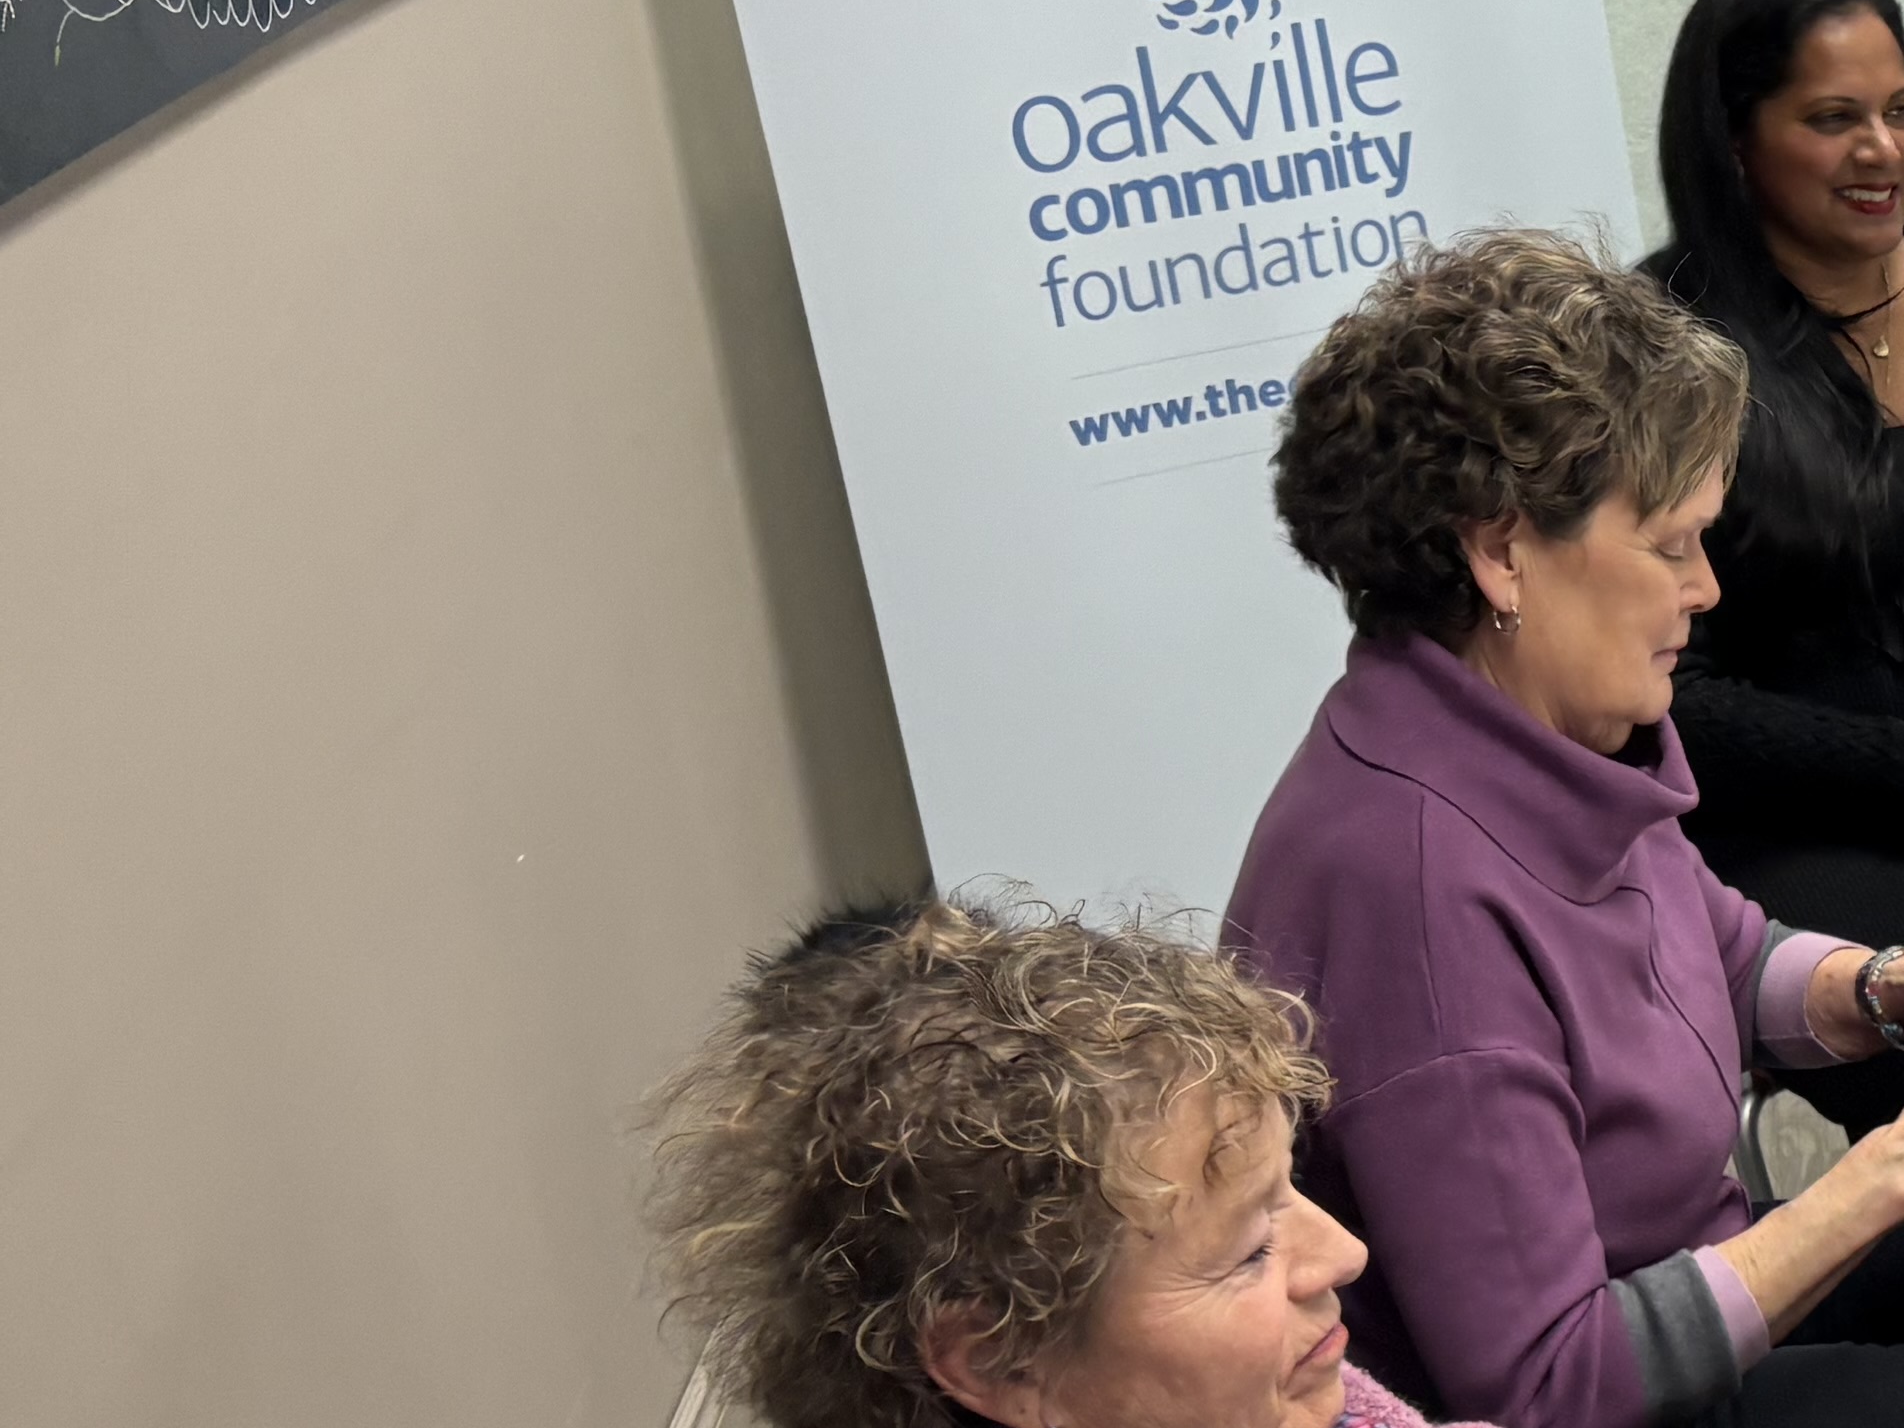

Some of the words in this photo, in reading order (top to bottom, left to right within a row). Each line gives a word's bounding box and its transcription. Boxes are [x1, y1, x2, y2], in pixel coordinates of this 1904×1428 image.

[1012, 18, 1402, 173] oakville
[1028, 130, 1412, 241] community
[1040, 208, 1430, 327] foundation
